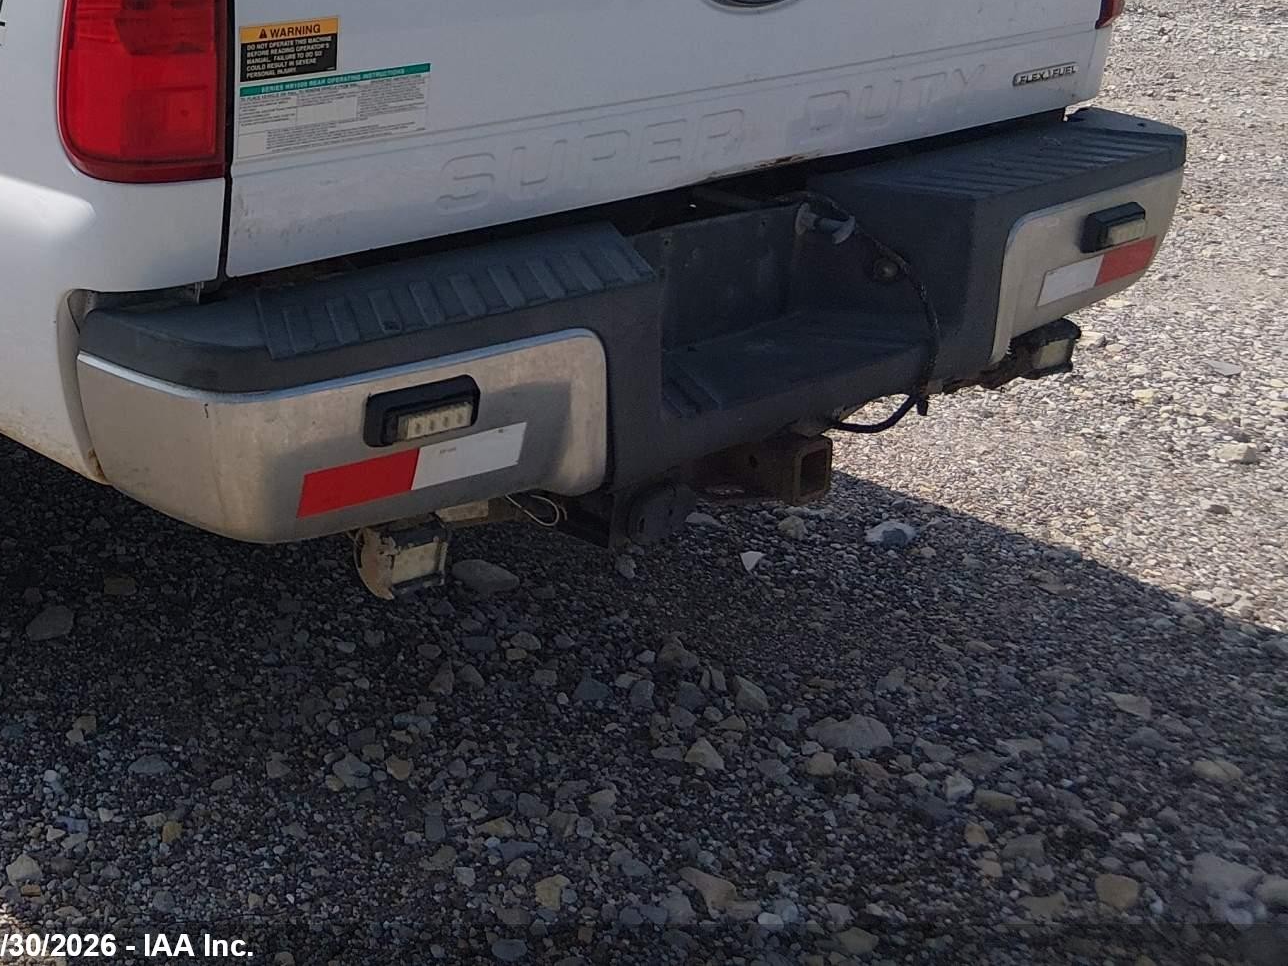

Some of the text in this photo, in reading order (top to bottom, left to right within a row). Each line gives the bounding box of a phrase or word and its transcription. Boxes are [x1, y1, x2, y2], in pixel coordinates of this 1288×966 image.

[270, 24, 321, 39] WARNING
[247, 43, 330, 58] BEFORE READING OPERATOR'S
[256, 42, 268, 50] NOT
[268, 40, 294, 49] OPERATE
[295, 38, 307, 46] THIS
[247, 57, 317, 72] COULD RESULT IN SEVERE
[273, 53, 297, 62] FAILURE
[247, 69, 276, 79] PERSONAL
[326, 74, 361, 84] OPERATING
[362, 68, 405, 80] INSTRUCTIONS
[1018, 65, 1077, 85] FLEX FUEL
[433, 63, 987, 214] SUPER DUTY
